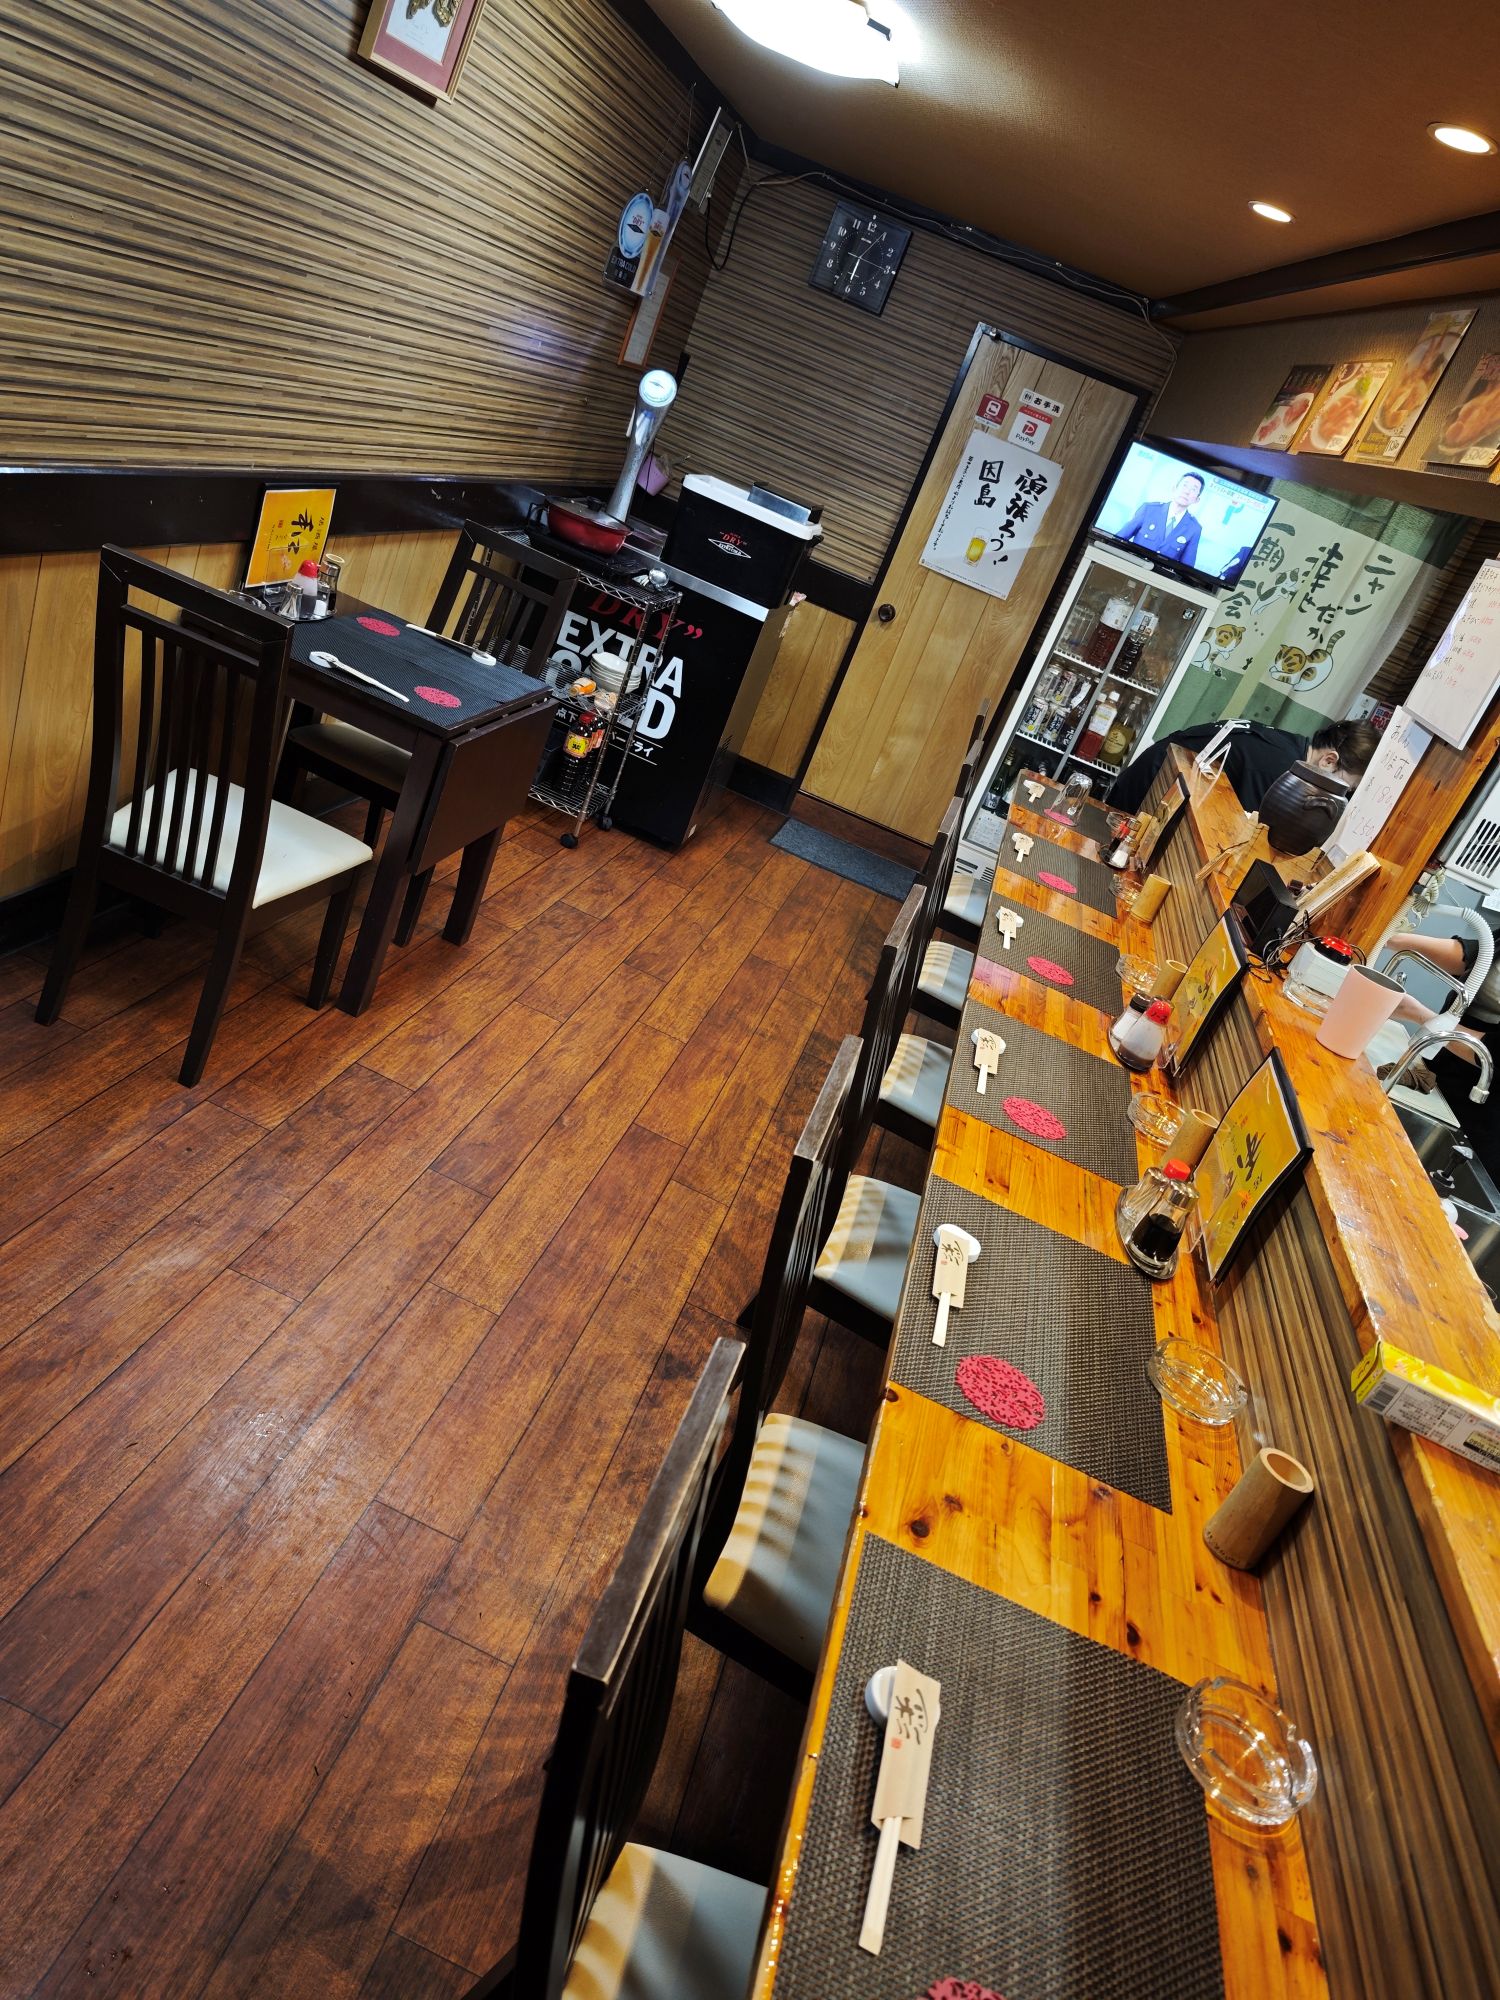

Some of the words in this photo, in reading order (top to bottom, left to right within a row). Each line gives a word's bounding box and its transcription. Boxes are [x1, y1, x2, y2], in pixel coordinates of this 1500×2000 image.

[852, 219, 861, 230] 11
[867, 221, 877, 232] 12
[837, 226, 847, 236] 10
[830, 241, 836, 249] 9
[886, 247, 894, 258] 2
[826, 258, 833, 268] 8
[884, 265, 891, 274] 3
[833, 275, 839, 285] 7
[874, 280, 880, 289] 4
[844, 285, 851, 293] 6
[859, 286, 866, 296] 5
[1015, 432, 1036, 446] PayPay
[974, 460, 1004, 508] 因島
[556, 609, 684, 698] EXTRA
